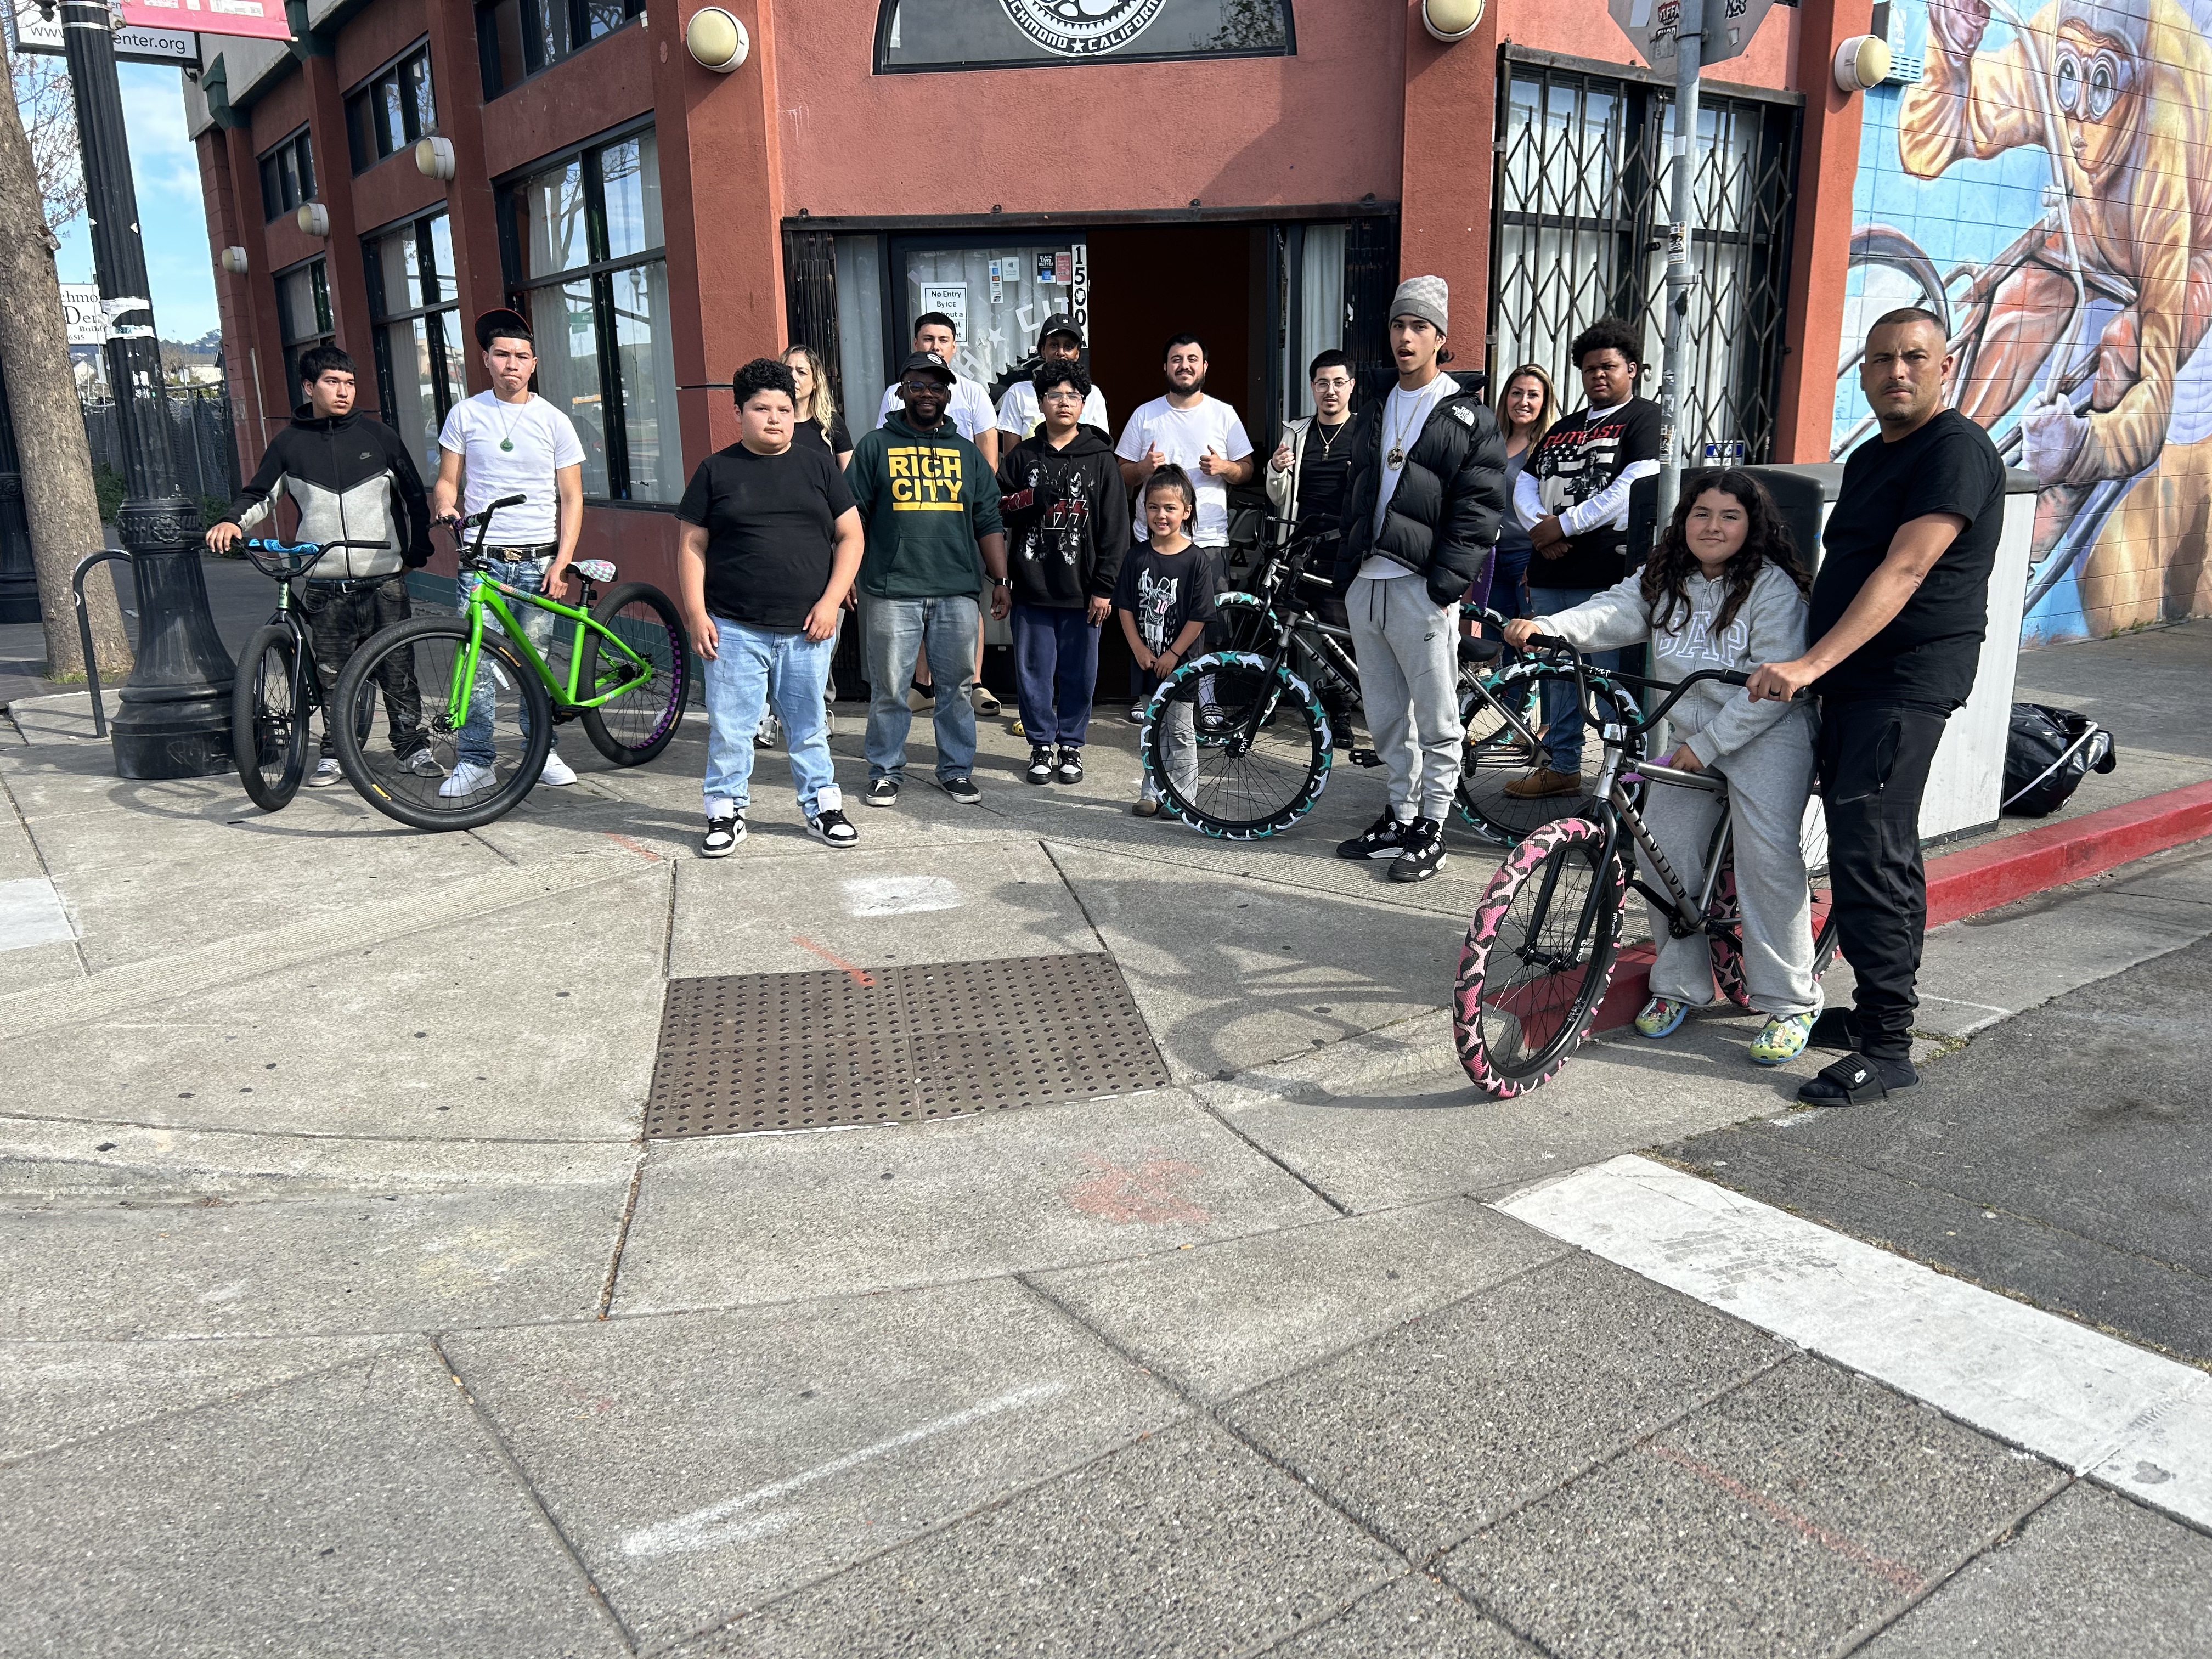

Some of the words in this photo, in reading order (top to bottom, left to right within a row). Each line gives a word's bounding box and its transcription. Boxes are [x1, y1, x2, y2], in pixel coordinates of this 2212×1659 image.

[1010, 0, 1068, 49] CHMOND
[888, 455, 962, 479] RICH
[891, 478, 963, 501] CITY
[1154, 599, 1168, 614] 10
[1655, 610, 1747, 668] GAP
[1625, 802, 1686, 900] DEVOTION
